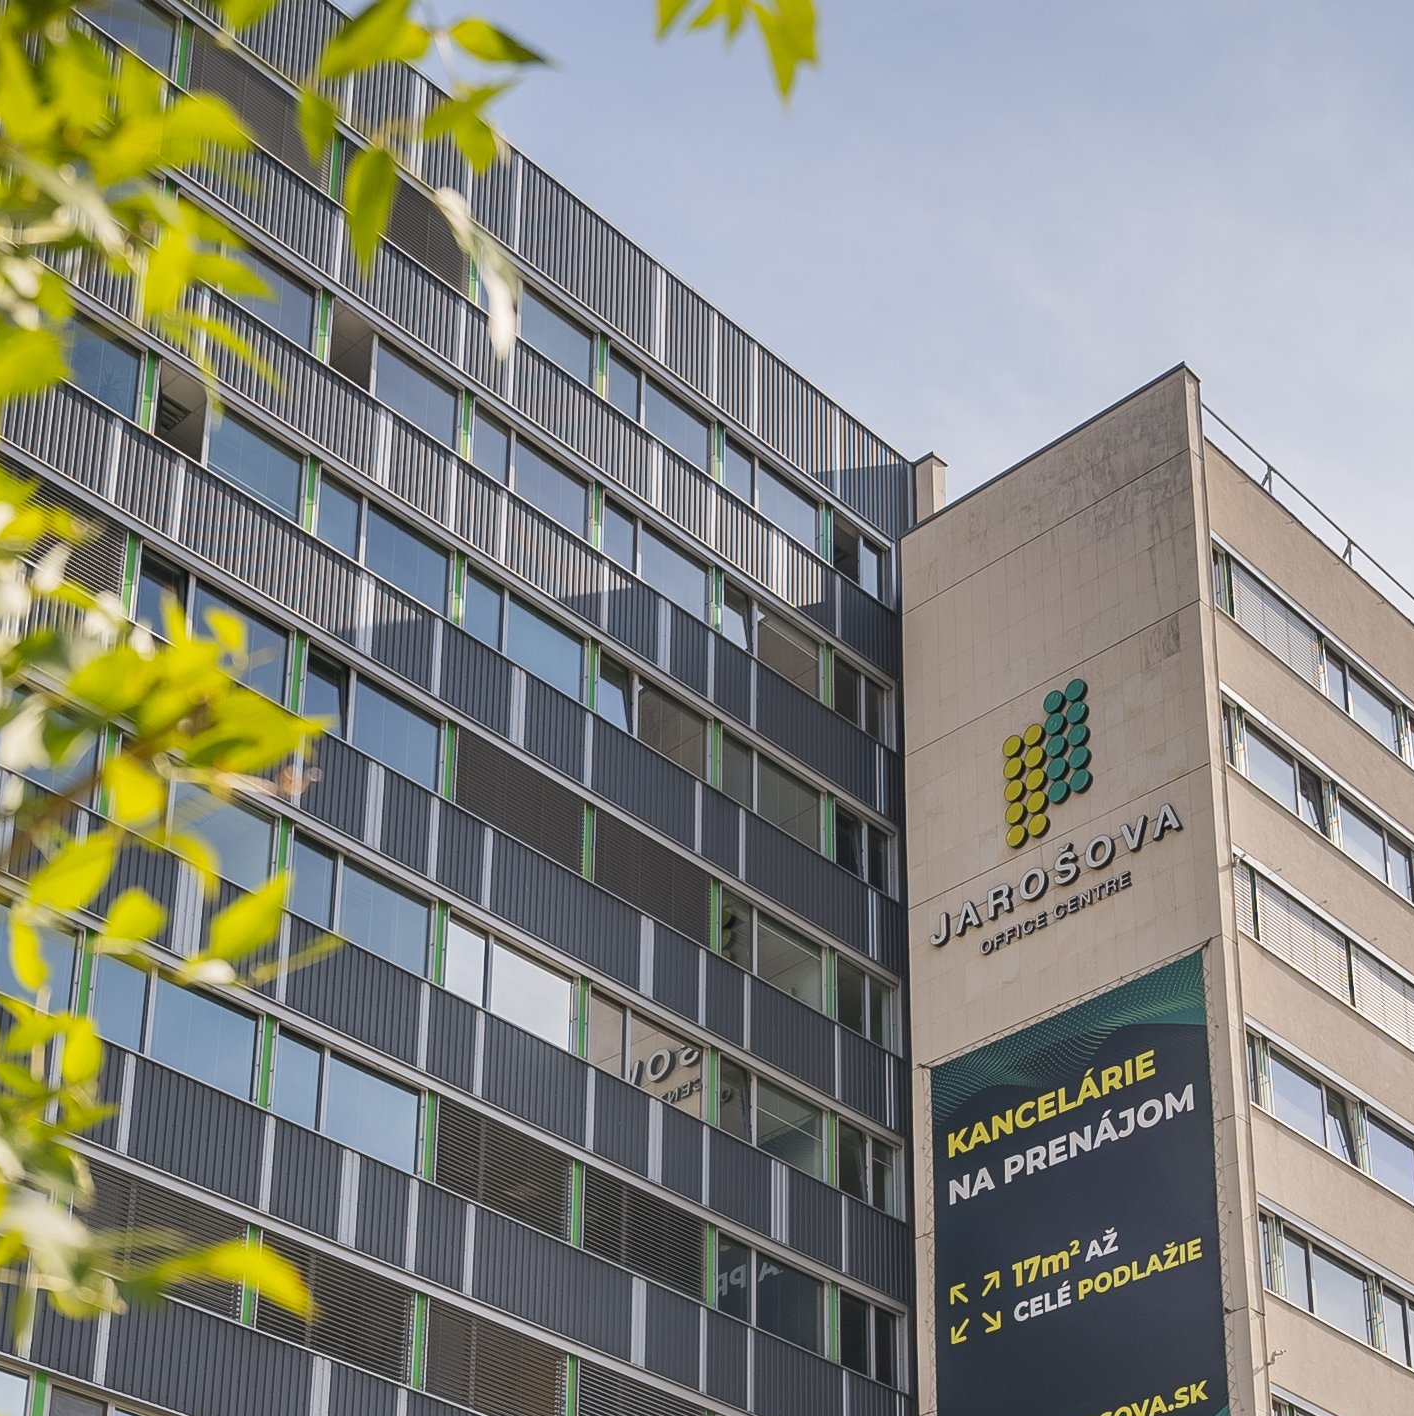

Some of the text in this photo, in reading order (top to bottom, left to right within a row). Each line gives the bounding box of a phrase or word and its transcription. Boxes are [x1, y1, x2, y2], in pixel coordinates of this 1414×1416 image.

[930, 803, 1183, 946] JAROŠOVA
[981, 871, 1132, 955] OFFICE CENTRE
[948, 1049, 1157, 1158] KANCELÁRIE
[948, 1083, 1195, 1205] NA PRENÁJOM
[1013, 1238, 1203, 1322] CELÉ PODLAŽIE
[1085, 1227, 1119, 1262] AŽ
